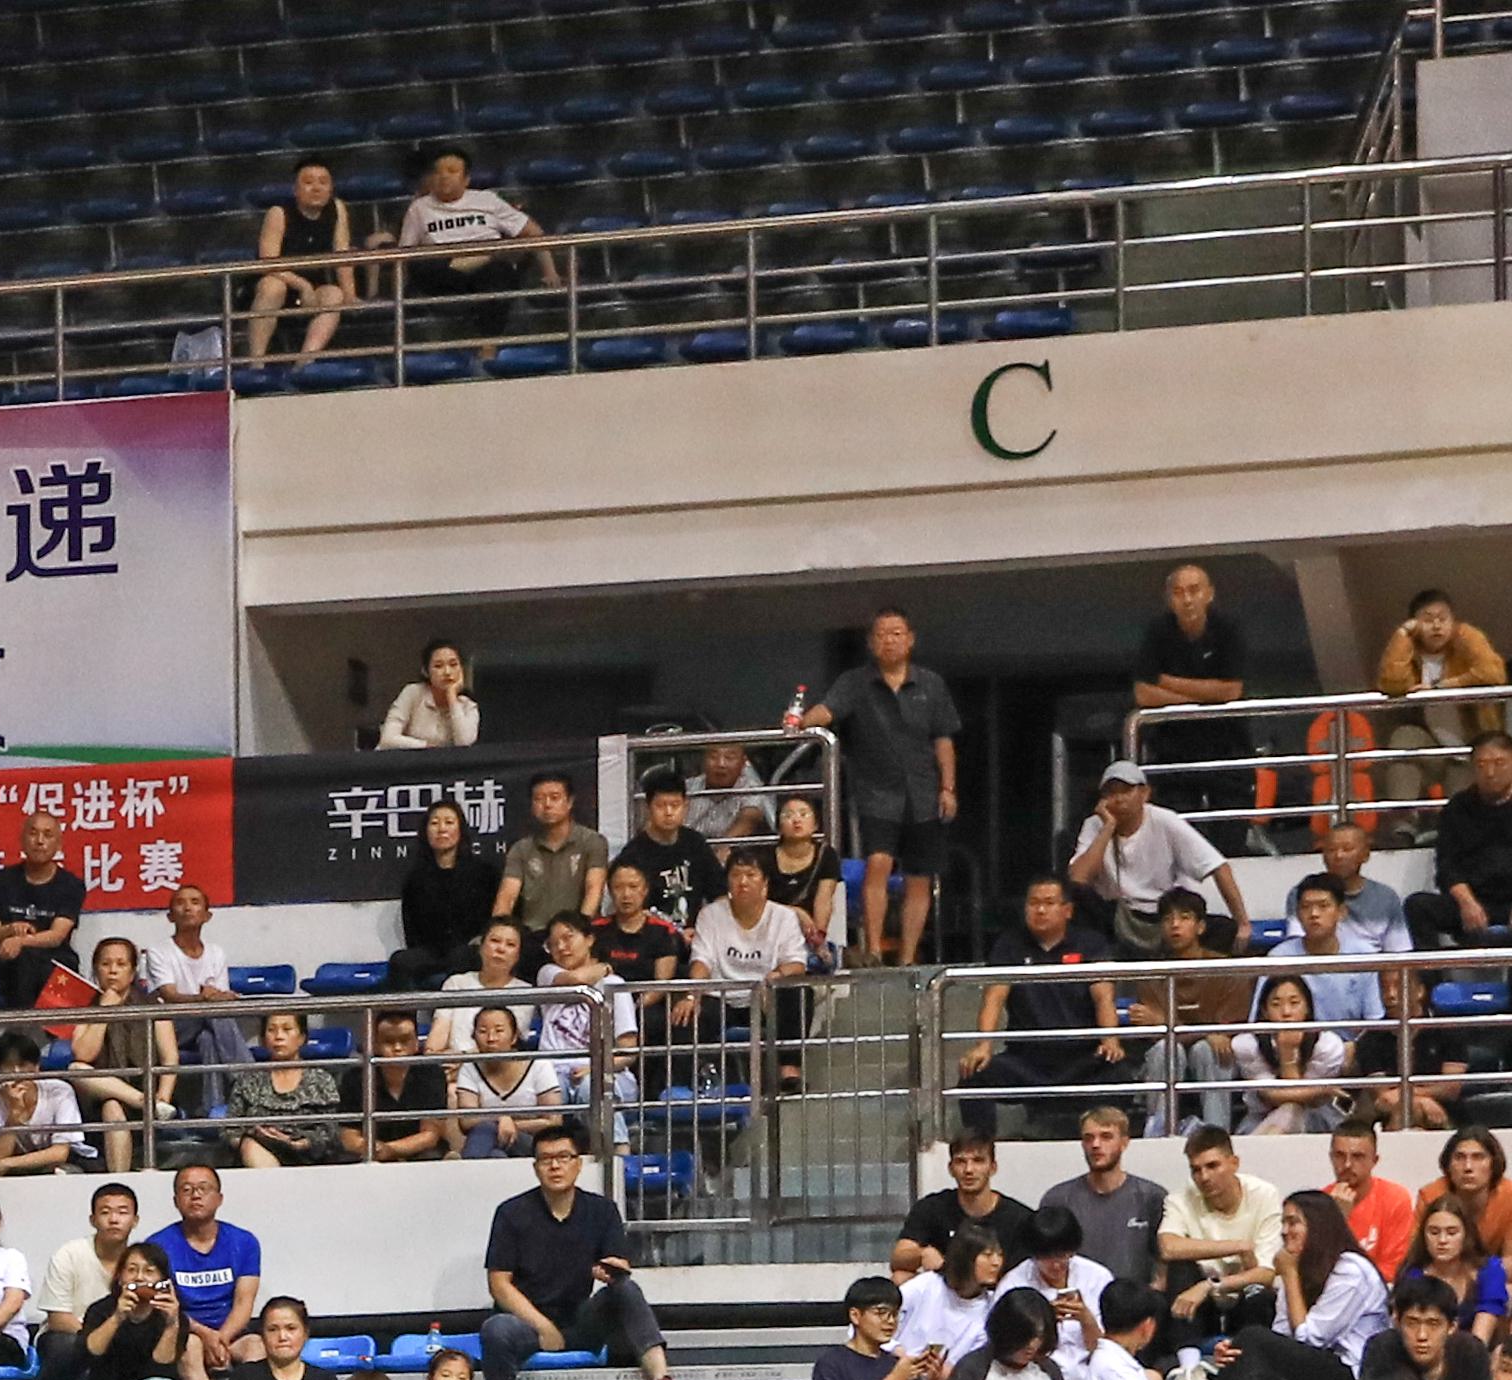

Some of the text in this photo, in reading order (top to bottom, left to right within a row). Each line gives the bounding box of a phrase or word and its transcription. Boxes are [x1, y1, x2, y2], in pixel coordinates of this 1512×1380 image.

[970, 359, 1057, 460] C
[327, 841, 508, 861] ZINNCH
[178, 1270, 229, 1285] LONSDALE
